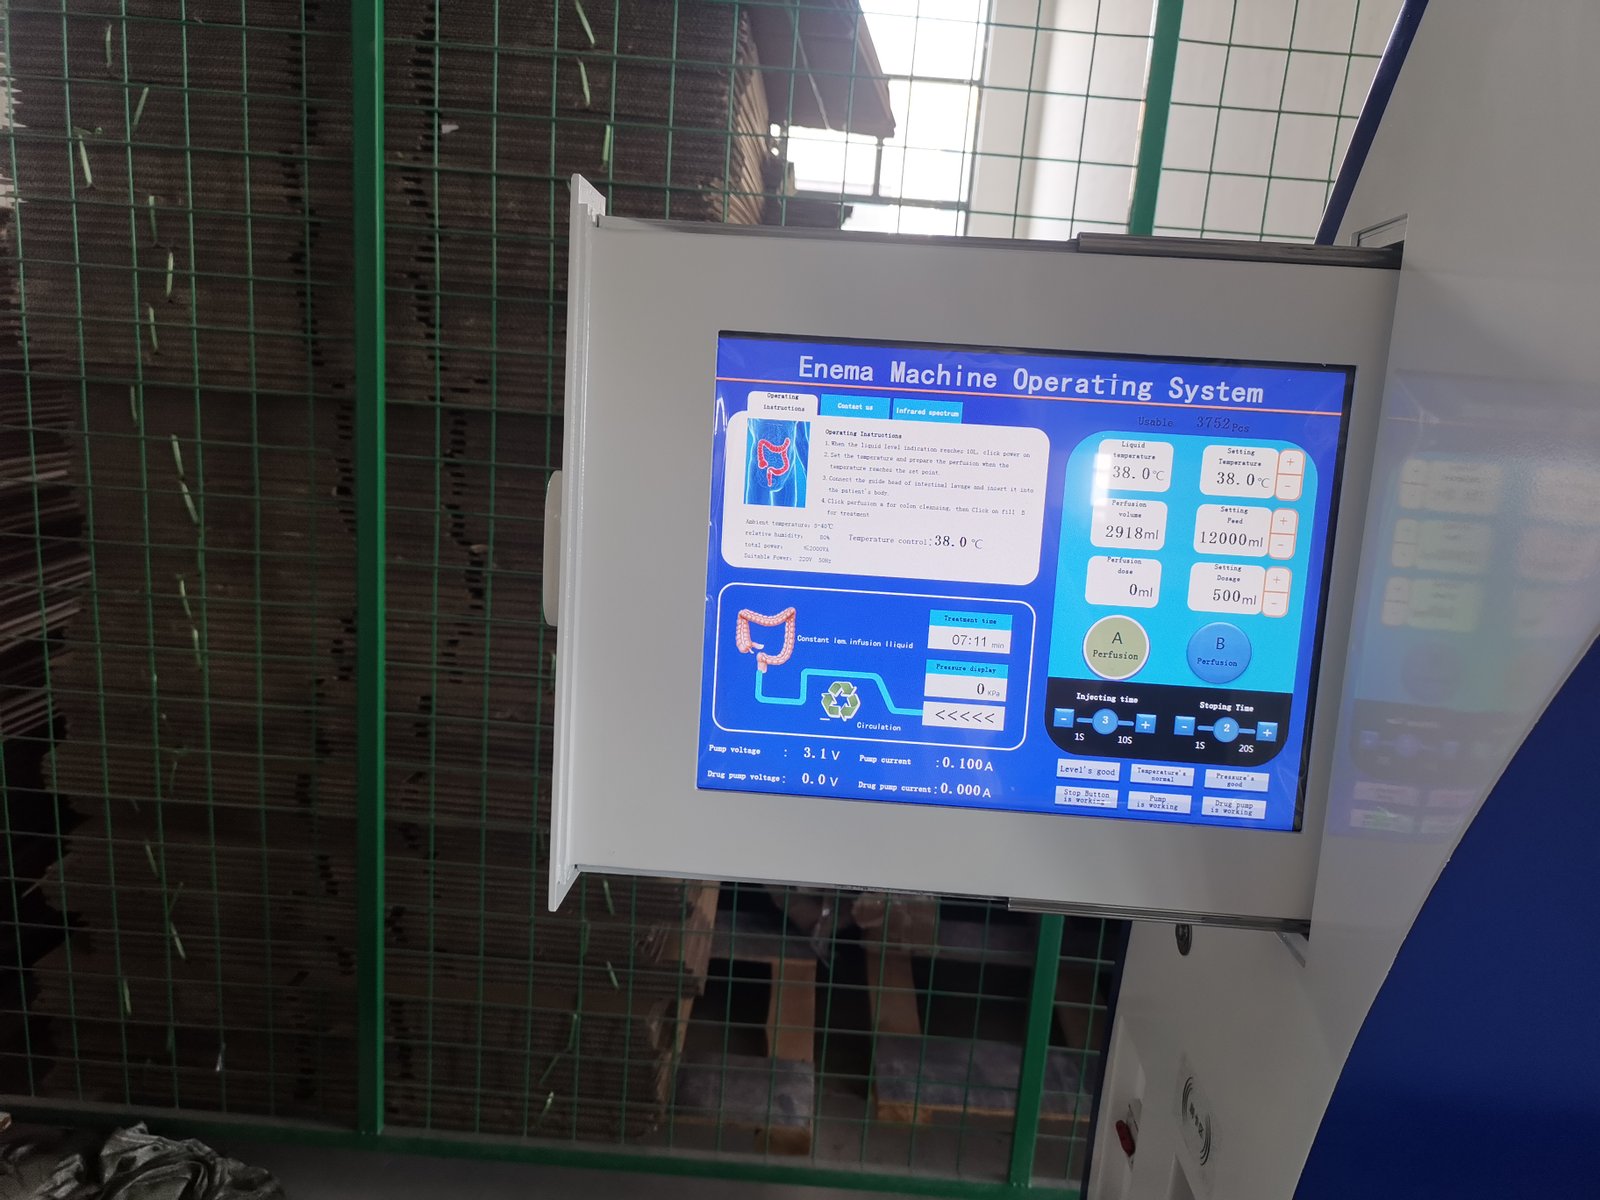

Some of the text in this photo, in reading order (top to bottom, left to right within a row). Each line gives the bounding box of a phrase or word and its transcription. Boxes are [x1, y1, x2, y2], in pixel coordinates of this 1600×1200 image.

[799, 356, 1264, 405] Enema Machine Operating System
[767, 393, 799, 401] Operating
[837, 402, 863, 410] Contact
[928, 410, 960, 418] spectrum
[1137, 416, 1174, 427] Usable
[825, 429, 903, 439] Operating Instructions
[1121, 441, 1146, 449] Liquid
[1113, 452, 1156, 460] temperature
[1227, 448, 1256, 457] Setting
[1219, 458, 1262, 467] Temperature
[1111, 500, 1147, 508] Perfusion
[840, 510, 870, 518] treatment
[1118, 511, 1142, 519] volume
[1220, 506, 1249, 515] Setting
[1105, 524, 1159, 540] 2918ml
[848, 533, 895, 543] Temperature
[1199, 531, 1264, 548] 12000ml
[1106, 556, 1143, 565] Perfusion
[1214, 563, 1243, 572] Setting
[1216, 574, 1241, 583] Dosage
[1212, 588, 1257, 606] 500ml
[943, 615, 979, 623] Treatment
[796, 634, 830, 644] Constant
[951, 634, 987, 647] 07:11
[1111, 631, 1123, 645] A
[1215, 637, 1226, 650] B
[1092, 649, 1139, 661] Perfusion
[1196, 657, 1238, 667] Perfusion
[935, 663, 997, 675] Pressure display
[976, 682, 985, 695] 0
[1076, 692, 1139, 704] Injecting time
[1199, 701, 1254, 713] Stoping Time
[1101, 715, 1109, 725] 3
[856, 721, 902, 732] Circulation
[1223, 722, 1231, 733] 2
[1074, 732, 1133, 745] 1S 10S
[1194, 741, 1255, 753] 1S 20S
[708, 744, 841, 761] Pump voltage 3.1 V
[859, 754, 878, 764] Pump
[880, 757, 912, 765] current
[1059, 764, 1116, 777] Level's good
[1137, 767, 1187, 777] Temperature's
[707, 770, 726, 780] Drug
[728, 772, 747, 781] pump
[801, 772, 826, 785] 0.0
[829, 776, 839, 787] V
[1151, 775, 1175, 783] normal
[1215, 772, 1255, 782] Pressure's
[857, 780, 877, 790] Drug
[879, 783, 898, 793] pump
[1063, 788, 1111, 799] Stop Button
[1149, 795, 1167, 805] Pump
[1215, 799, 1254, 810] Drug pump
[1148, 802, 1179, 812] working
[1222, 807, 1253, 817] working
